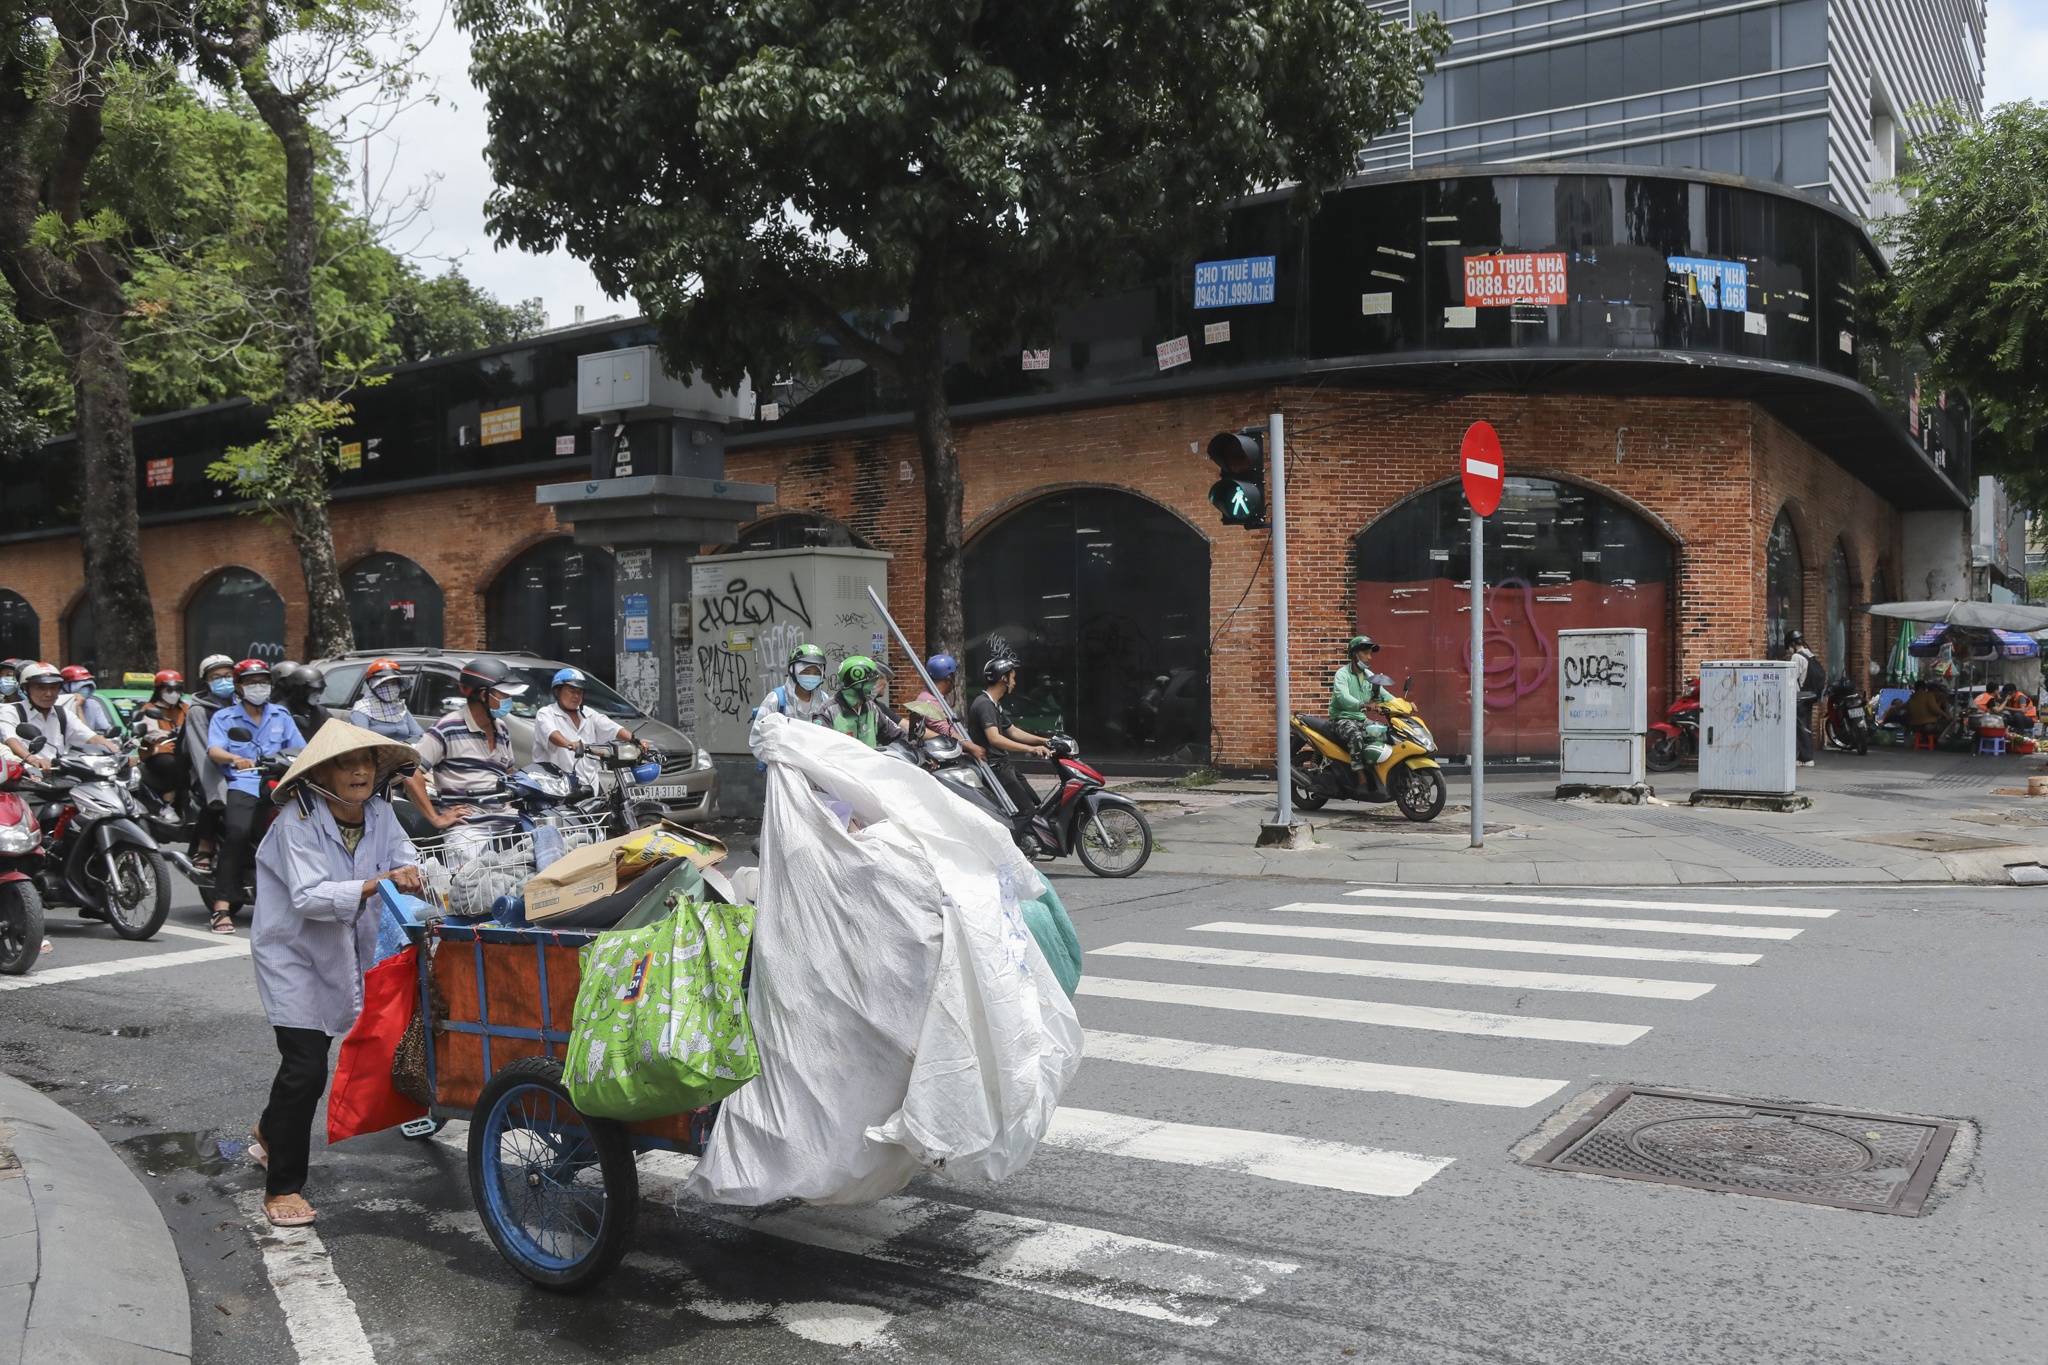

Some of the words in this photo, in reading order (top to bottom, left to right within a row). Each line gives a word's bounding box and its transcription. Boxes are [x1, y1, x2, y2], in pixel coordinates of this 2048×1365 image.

[1196, 266, 1218, 285] CHO
[1221, 259, 1249, 282] THUÊ
[1252, 257, 1273, 279] NHÀ
[1466, 260, 1494, 276] CHO
[1498, 255, 1533, 274] THUÊ
[1537, 254, 1564, 273] NHÀ
[1725, 264, 1746, 286] NHÀ
[1195, 282, 1253, 307] 0943.61.9998
[1467, 273, 1565, 297] 0888.920.130
[1496, 297, 1510, 305] Liên
